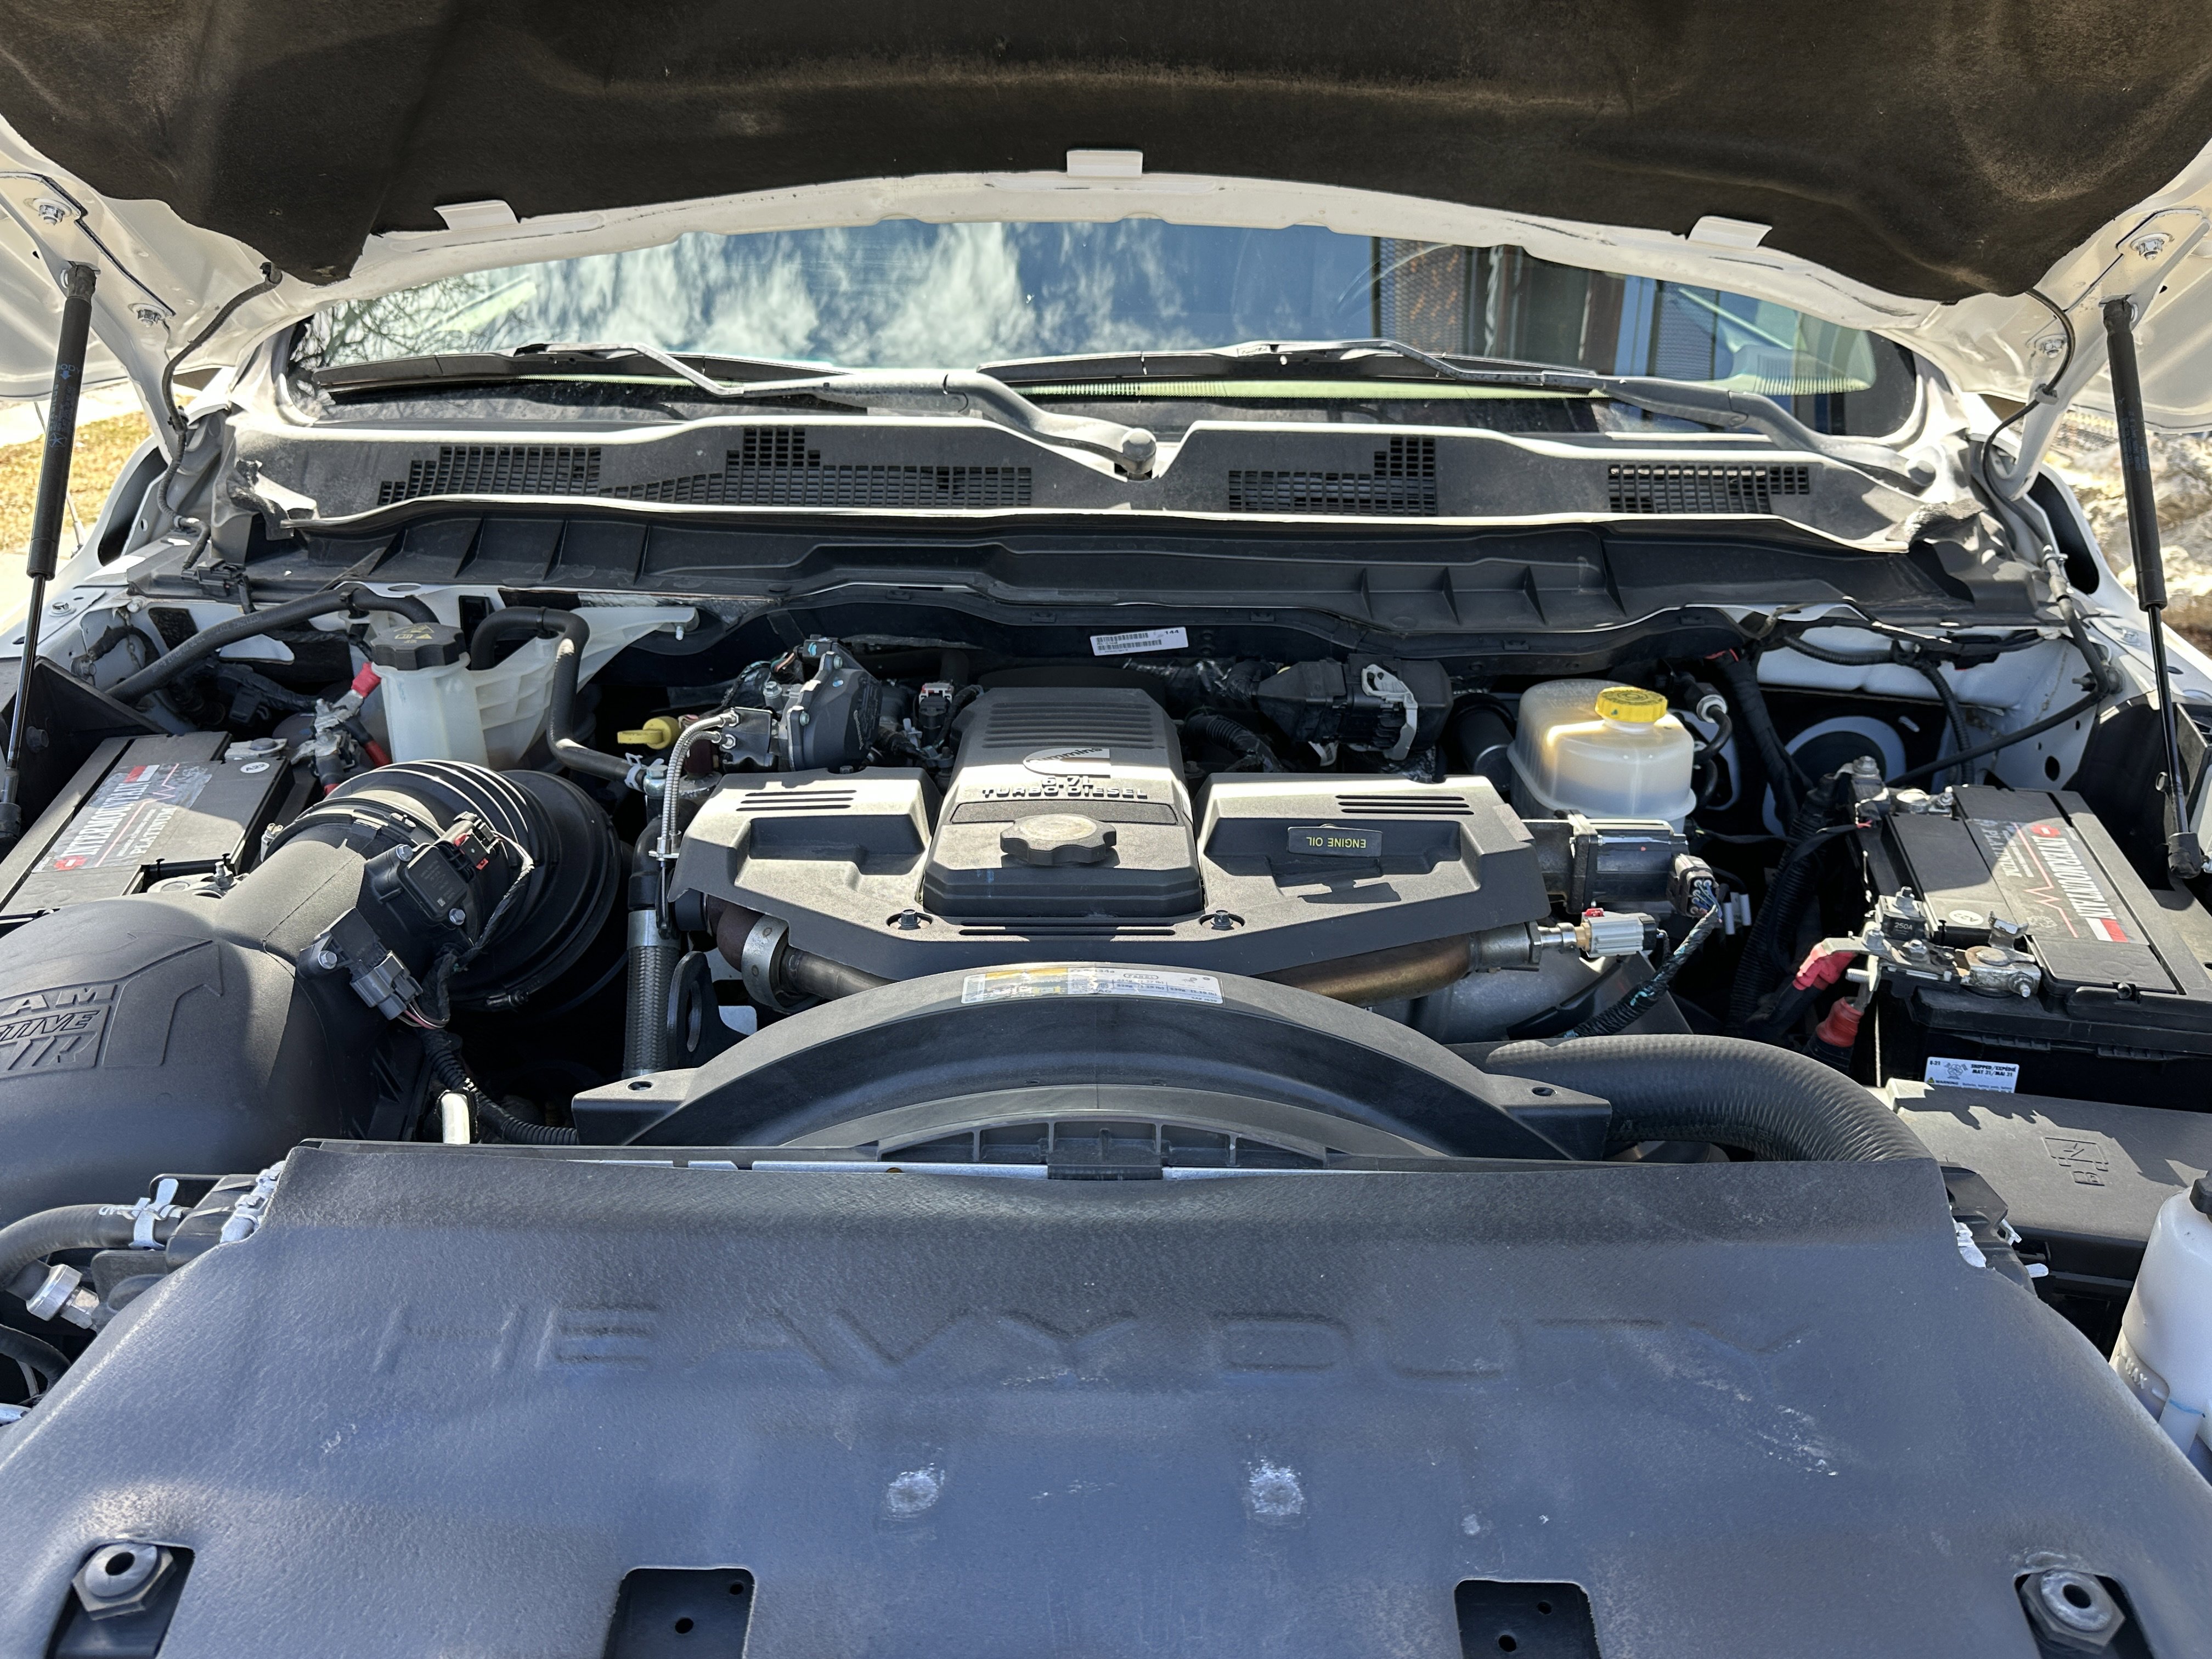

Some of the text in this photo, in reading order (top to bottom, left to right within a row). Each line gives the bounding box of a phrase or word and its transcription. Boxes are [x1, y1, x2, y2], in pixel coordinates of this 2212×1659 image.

[982, 786, 1148, 799] TURBO DIESEL
[1042, 775, 1093, 788] 6.7L
[60, 782, 152, 857] INTERMOUNTAIN
[129, 806, 178, 855] PLATINUM
[1306, 837, 1366, 848] ENGINE OIL
[1981, 828, 2022, 878] PLATINUM
[2032, 835, 2117, 920] INTERMOUNTAIN
[1894, 922, 1913, 930] 250A
[0, 985, 117, 1018] AM
[2125, 1357, 2148, 1389] MAX
